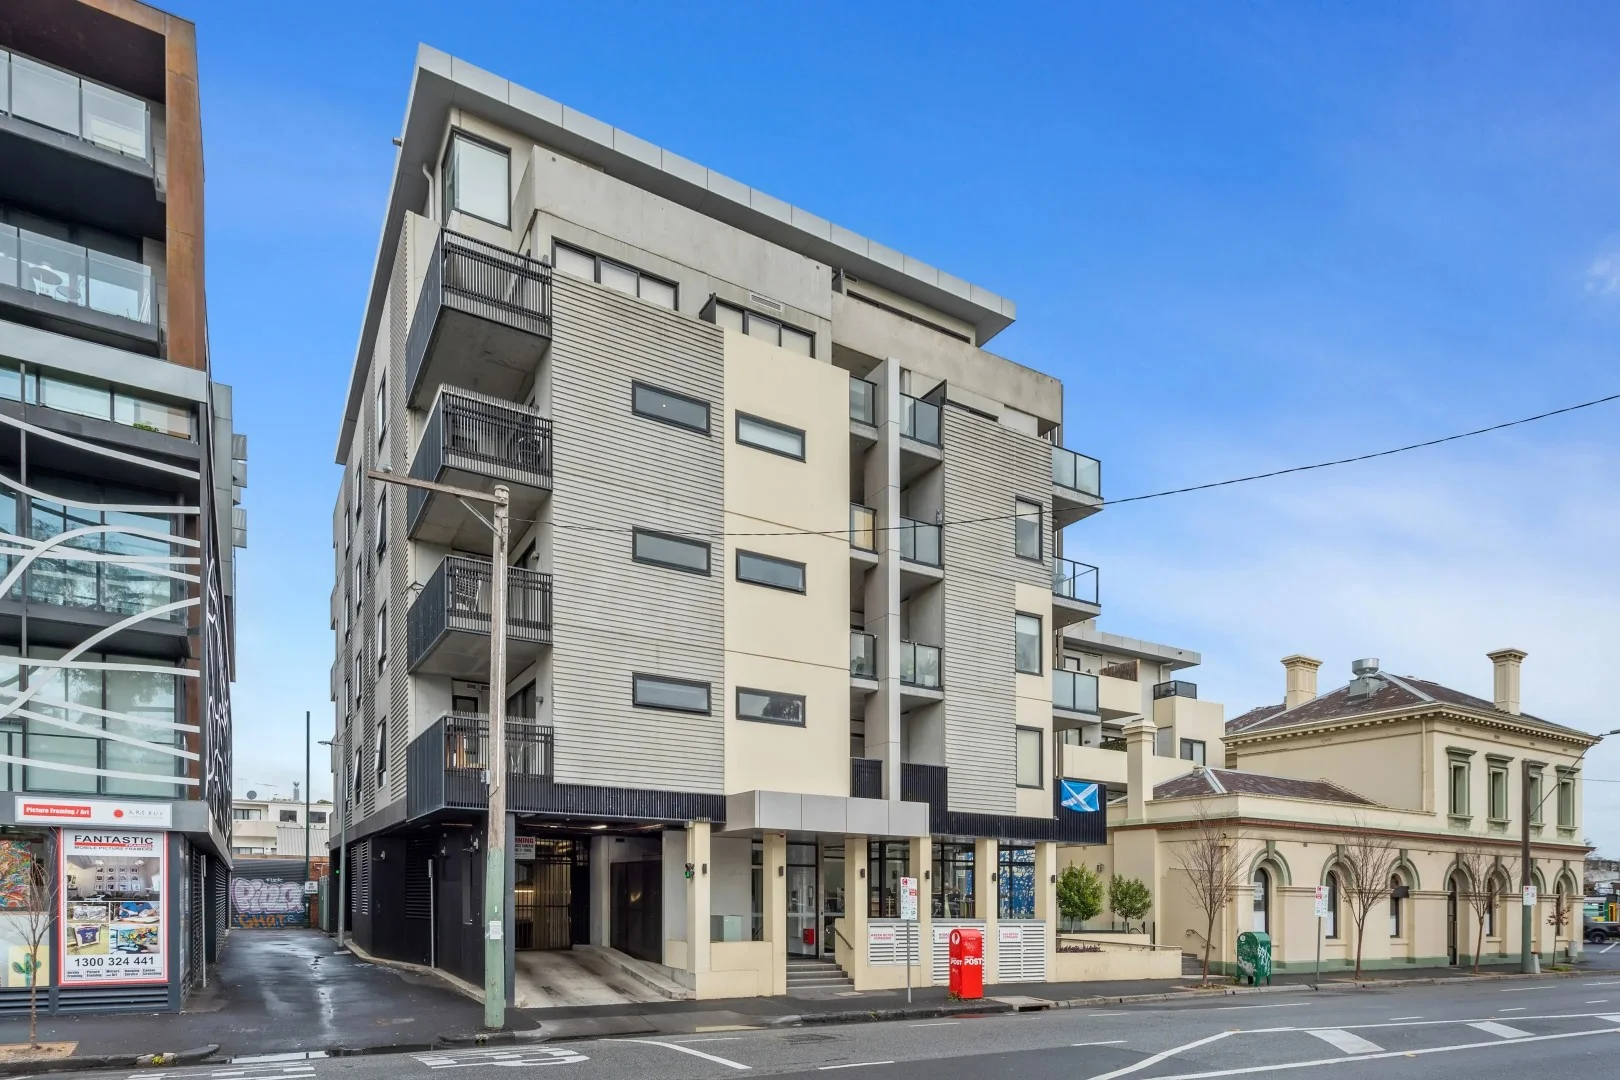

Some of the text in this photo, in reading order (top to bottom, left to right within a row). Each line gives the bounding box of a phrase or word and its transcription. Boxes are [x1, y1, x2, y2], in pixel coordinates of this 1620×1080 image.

[50, 807, 75, 816] Framing
[74, 834, 154, 844] FANTASTIC
[75, 956, 154, 966] 1300 324 441
